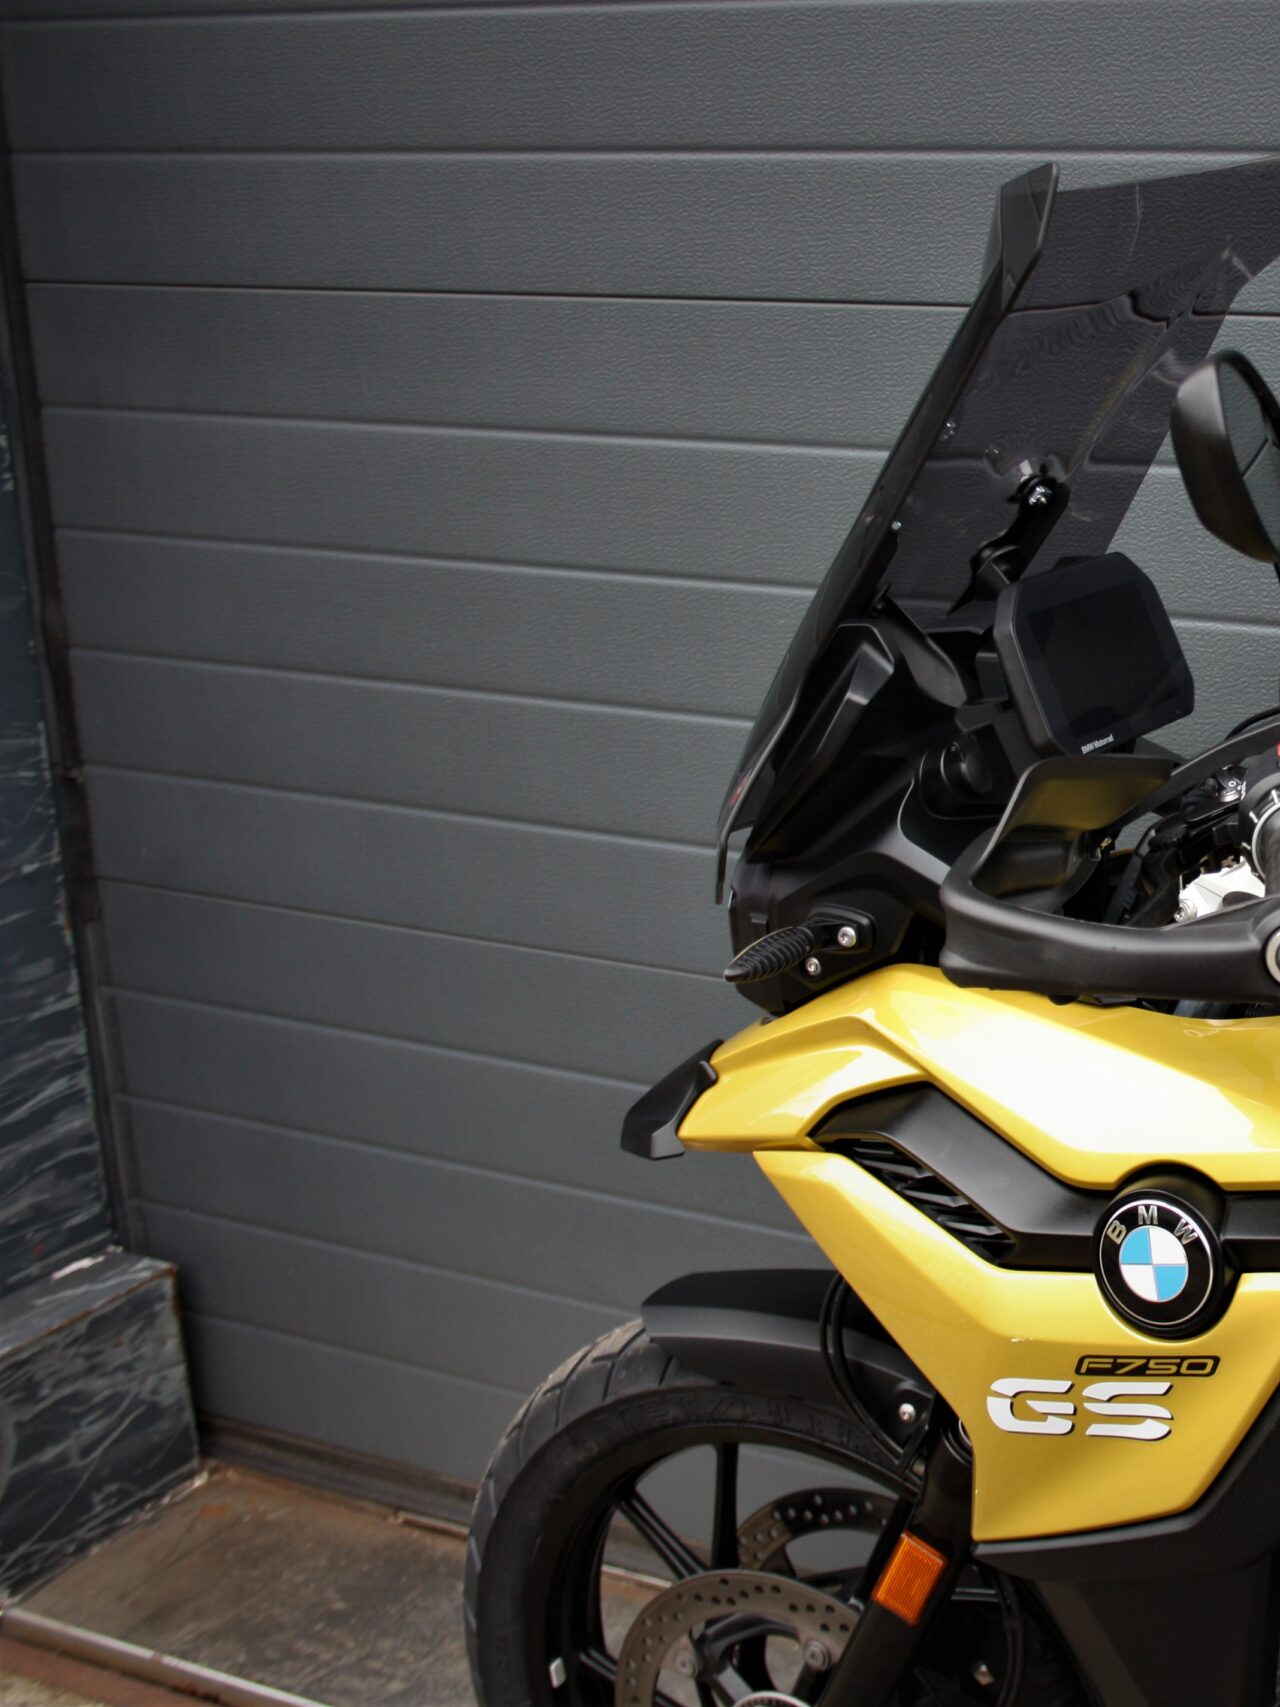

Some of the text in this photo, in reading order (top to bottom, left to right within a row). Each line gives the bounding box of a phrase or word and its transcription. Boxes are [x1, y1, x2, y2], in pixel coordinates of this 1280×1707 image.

[1106, 1204, 1199, 1247] BMW
[1079, 1358, 1214, 1375] F750
[986, 1378, 1173, 1440] GS
